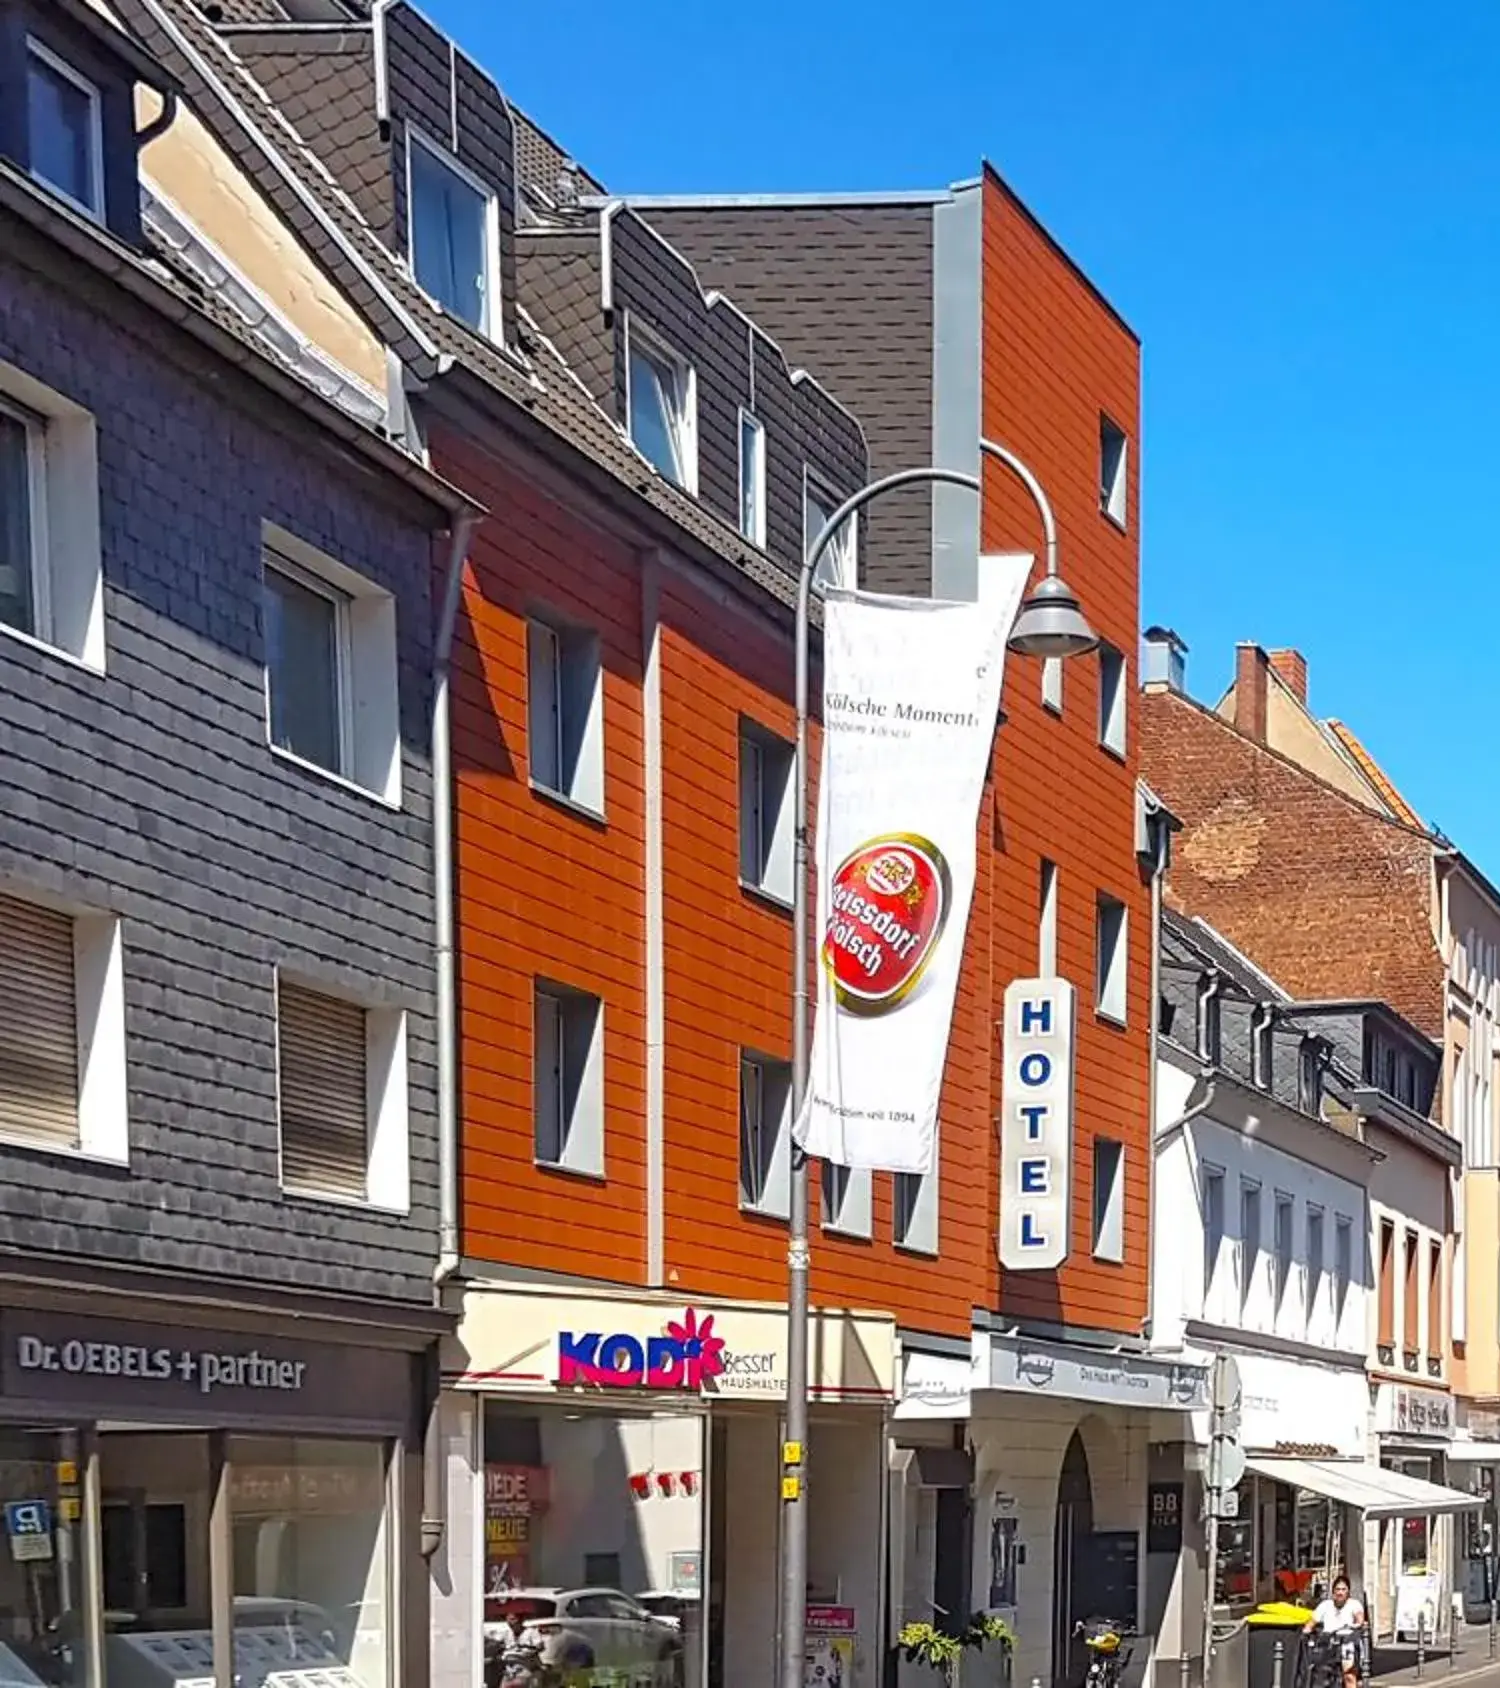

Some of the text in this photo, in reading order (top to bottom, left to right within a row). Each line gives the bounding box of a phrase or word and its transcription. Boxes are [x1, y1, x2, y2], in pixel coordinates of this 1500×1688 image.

[832, 883, 922, 960] eissdorf
[1019, 999, 1052, 1247] HOTEL
[61, 1340, 171, 1378] OEBELS
[201, 1351, 306, 1393] partner
[721, 1377, 789, 1391] HAUSHALTE
[723, 1350, 777, 1375] Besser
